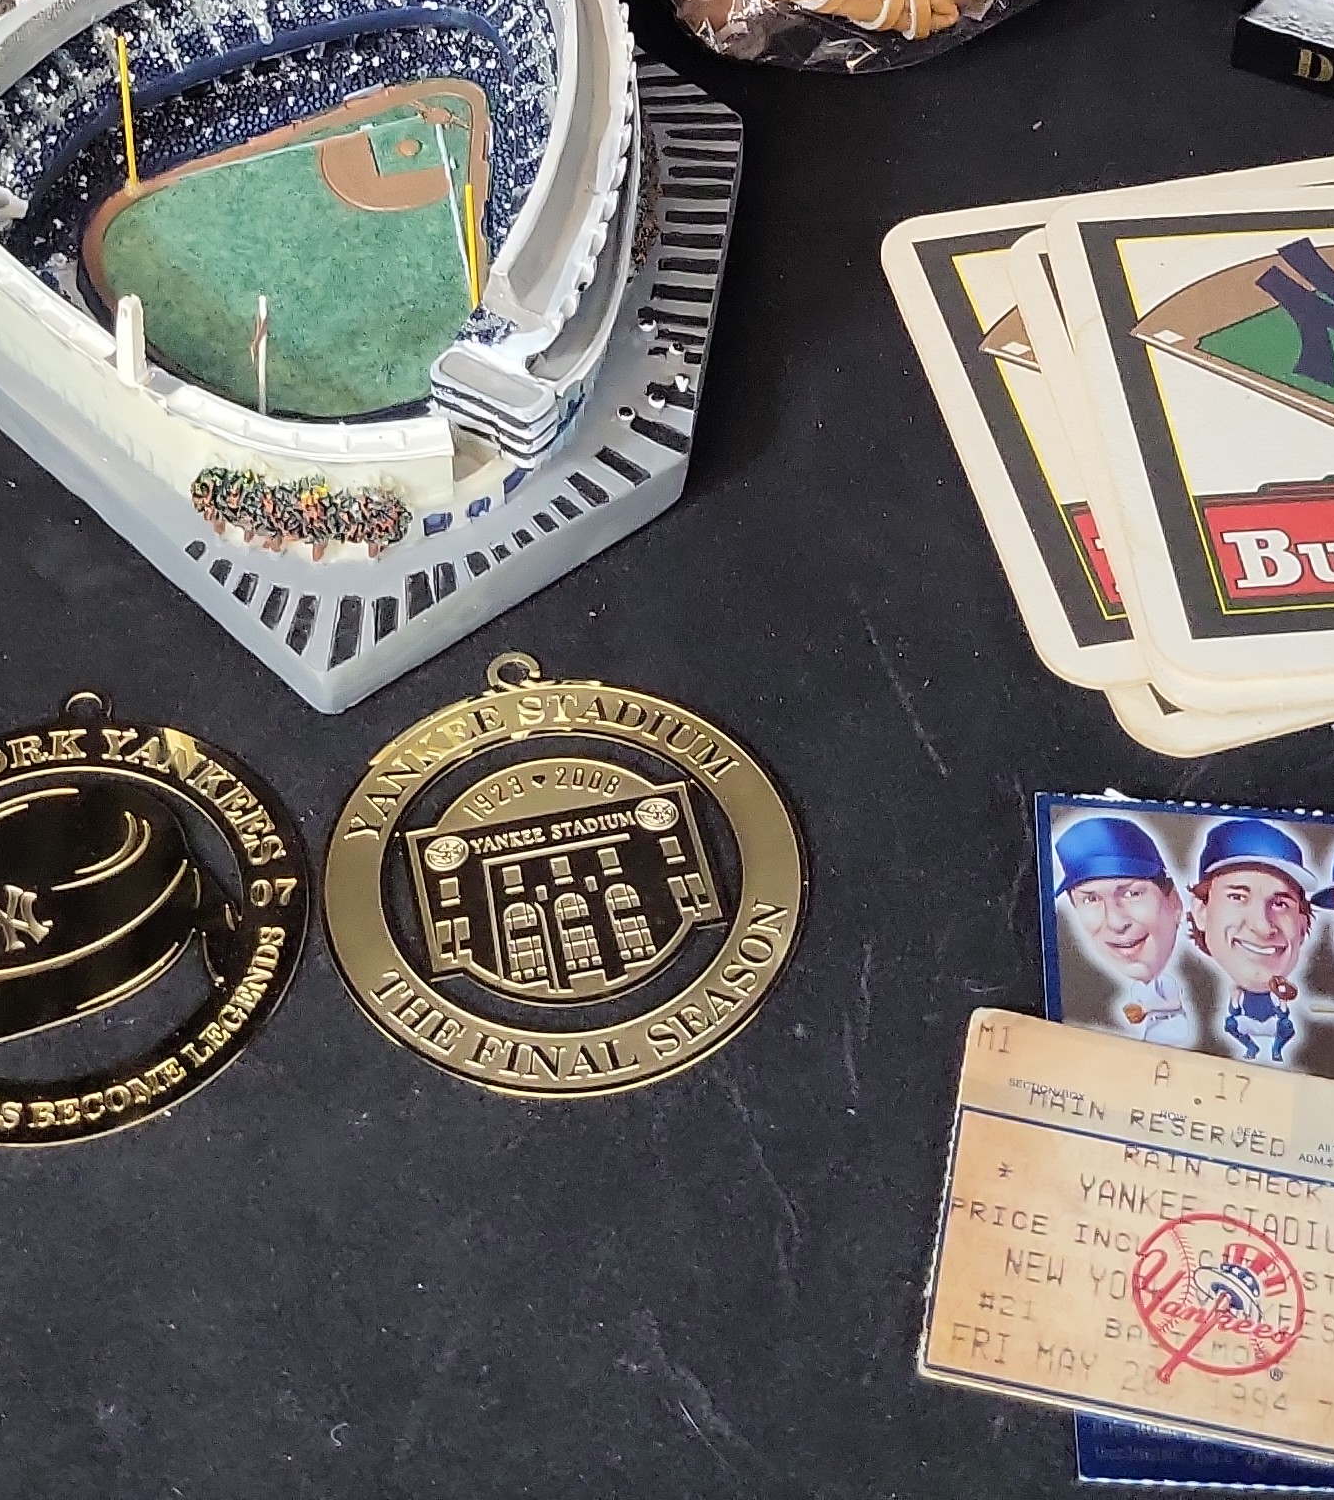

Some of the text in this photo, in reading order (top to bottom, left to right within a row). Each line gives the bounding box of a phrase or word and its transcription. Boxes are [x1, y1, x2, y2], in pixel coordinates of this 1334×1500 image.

[343, 693, 740, 842] YANKEE STADIUM
[462, 765, 622, 822] 1923 2008
[100, 727, 289, 867] YANKEES
[469, 810, 637, 857] YANKEE STADIUM
[249, 877, 299, 907] 07
[367, 897, 790, 1083] THE FINAL SEASON
[28, 1055, 190, 1129] BECOME
[180, 926, 287, 1071] LEGENDS
[1153, 1059, 1172, 1088] A
[1214, 1071, 1252, 1104] 17
[1029, 1086, 1287, 1159] MAIN RESERVED
[1079, 1173, 1199, 1226] YANKEE
[1123, 1143, 1323, 1203] RAIN CHECK
[950, 1196, 1050, 1236] PRICE
[1004, 1246, 1066, 1287] NEW
[951, 1321, 1011, 1365] FRI
[1036, 1340, 1099, 1382] MAY
